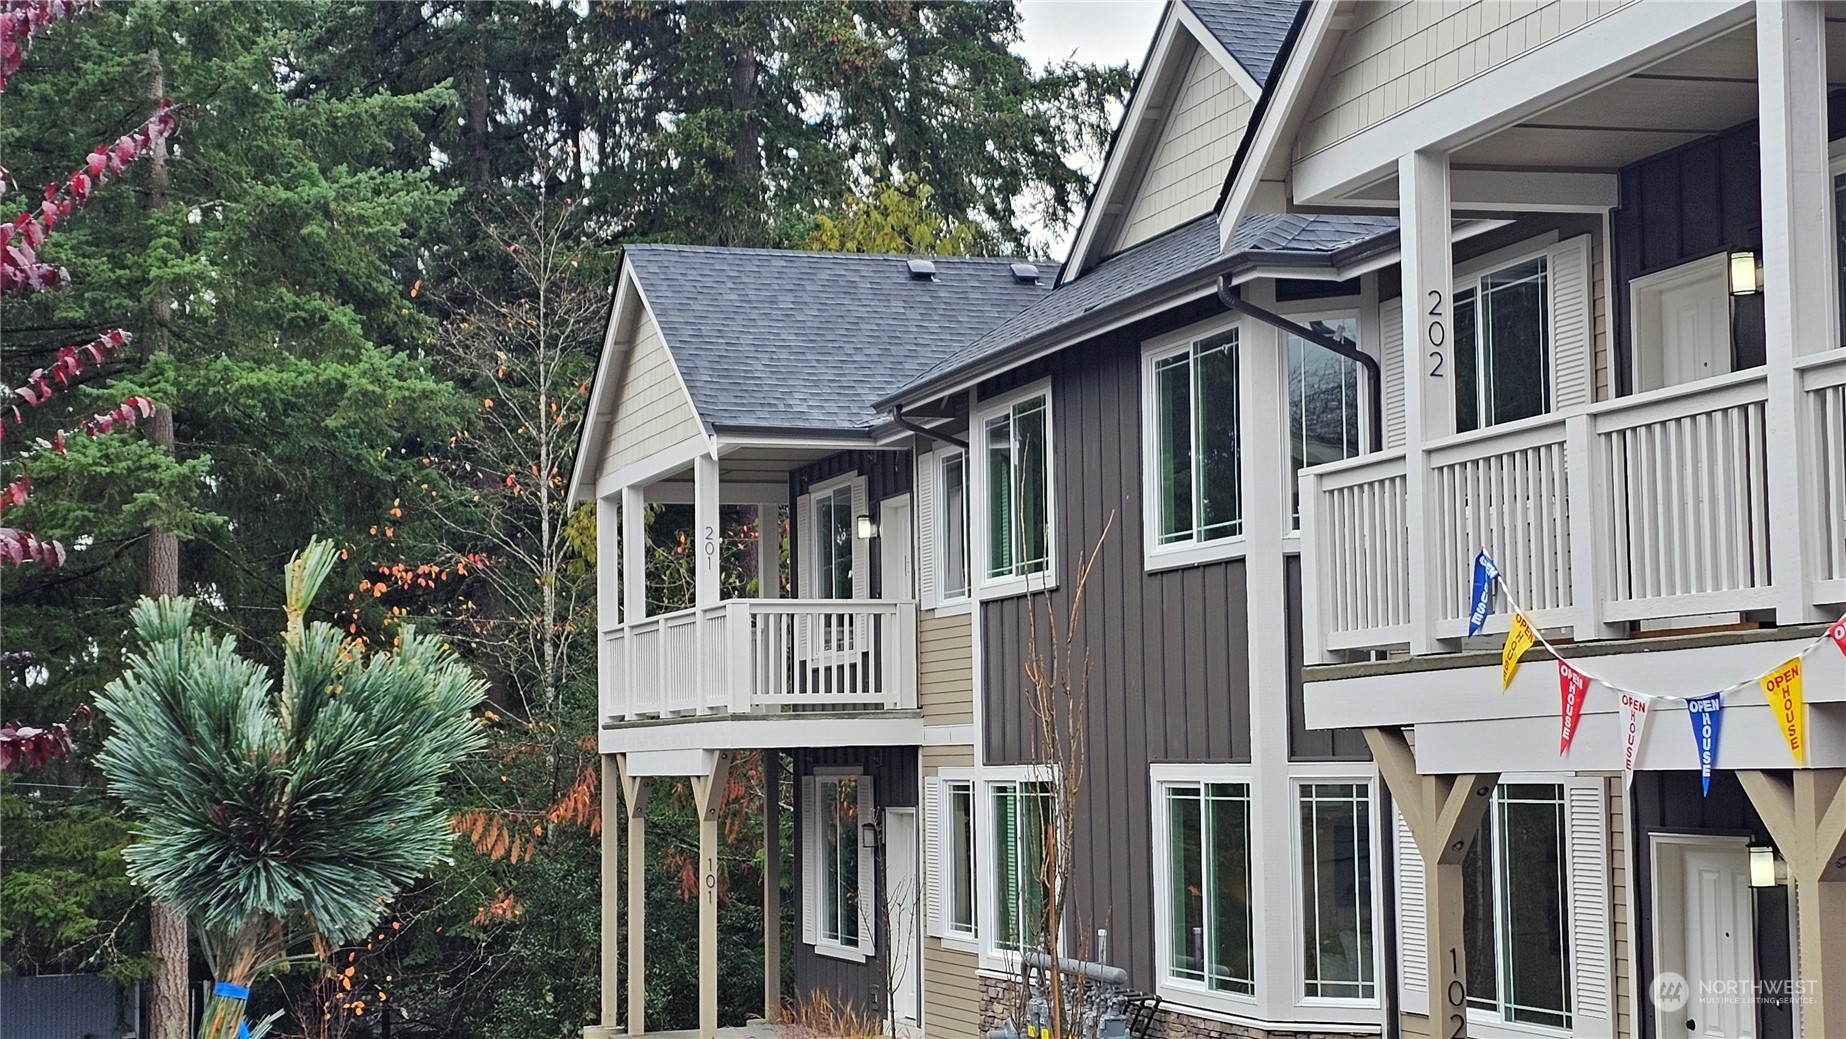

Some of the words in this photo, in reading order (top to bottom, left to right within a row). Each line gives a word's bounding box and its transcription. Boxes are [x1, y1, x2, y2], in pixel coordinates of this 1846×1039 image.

[1428, 290, 1444, 377] 202
[705, 526, 714, 570] 201
[1515, 613, 1534, 643] OPEN
[1560, 664, 1583, 690] OPEN
[1766, 665, 1799, 692] OPEN
[1562, 680, 1576, 740] HOUSE
[1621, 694, 1646, 713] OPEN
[1689, 698, 1720, 713] OPEN
[1782, 685, 1800, 750] HOUSE
[1625, 710, 1636, 771] HOUSE
[1702, 712, 1712, 777] HOUSE
[706, 858, 715, 905] 101
[1448, 947, 1465, 1039] 102
